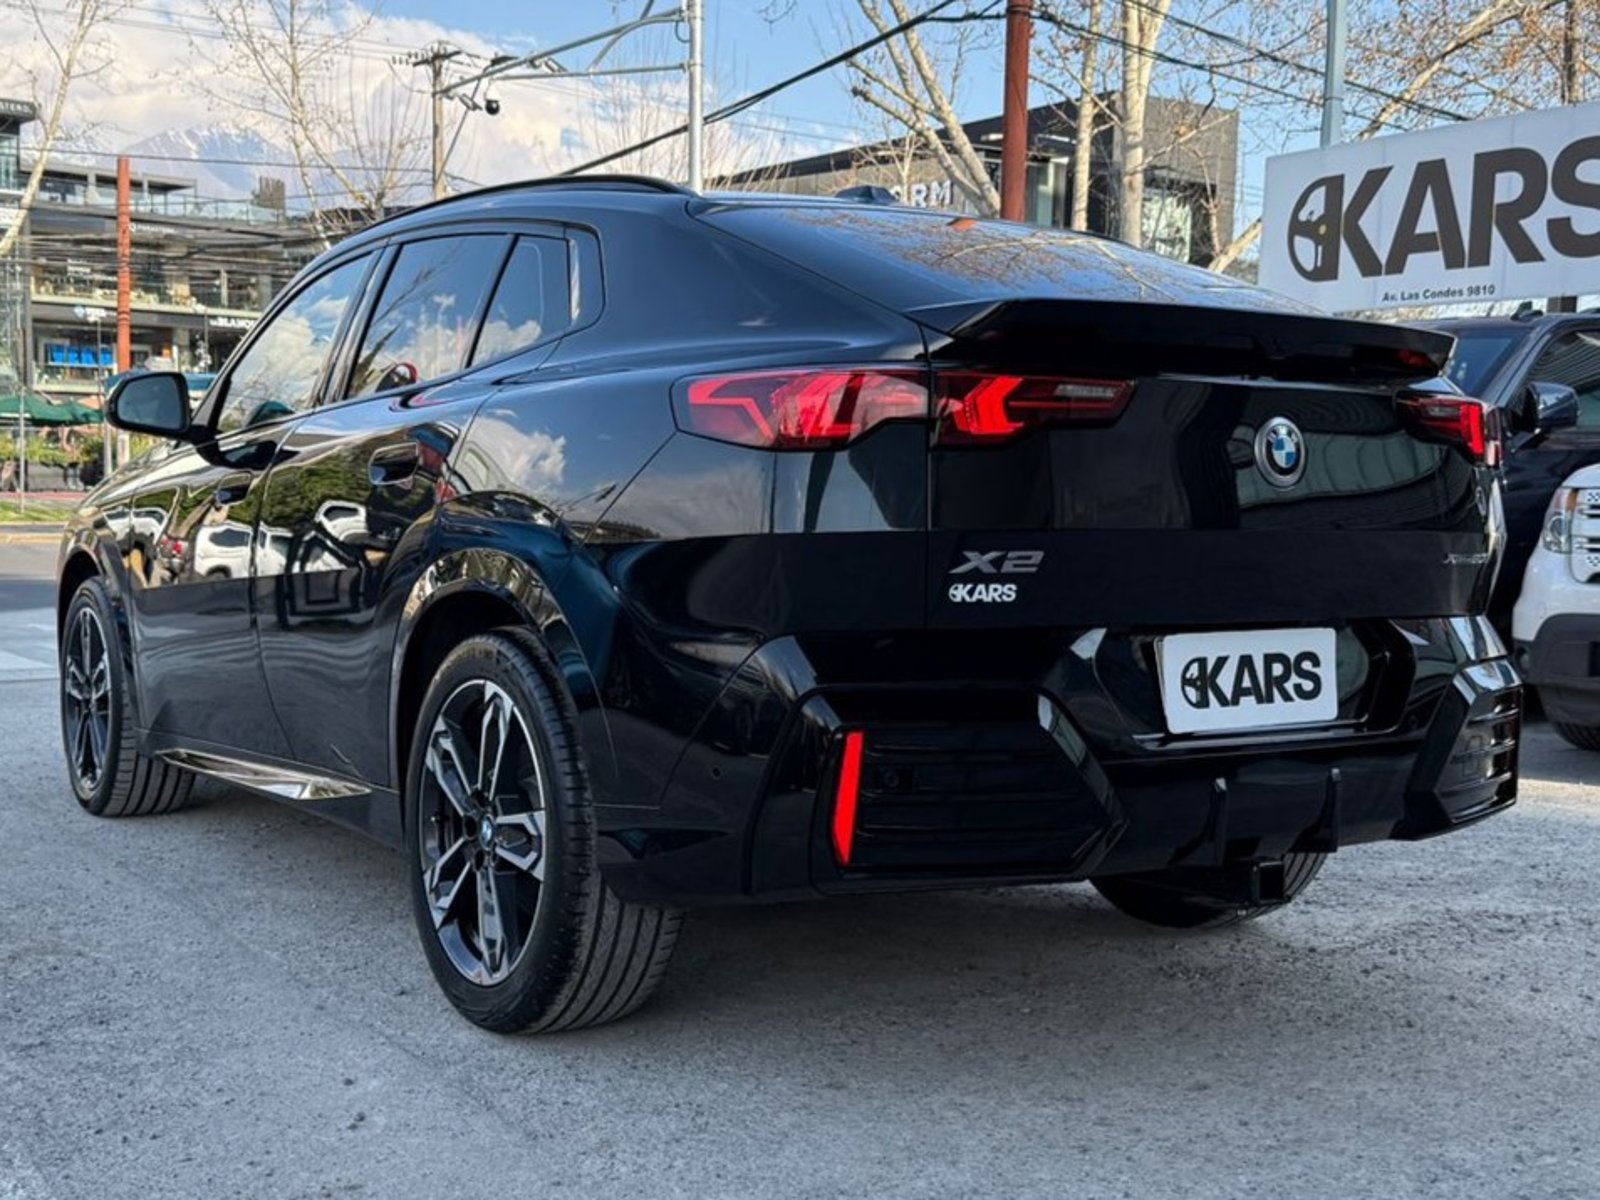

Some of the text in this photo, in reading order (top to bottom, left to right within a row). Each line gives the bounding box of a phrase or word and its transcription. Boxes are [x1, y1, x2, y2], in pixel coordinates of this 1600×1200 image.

[1288, 135, 1600, 283] KARS
[1382, 283, 1496, 302] Av. Las Condes 9810
[947, 550, 1044, 574] X2
[948, 582, 1018, 603] KARS
[1181, 651, 1322, 710] KARS
